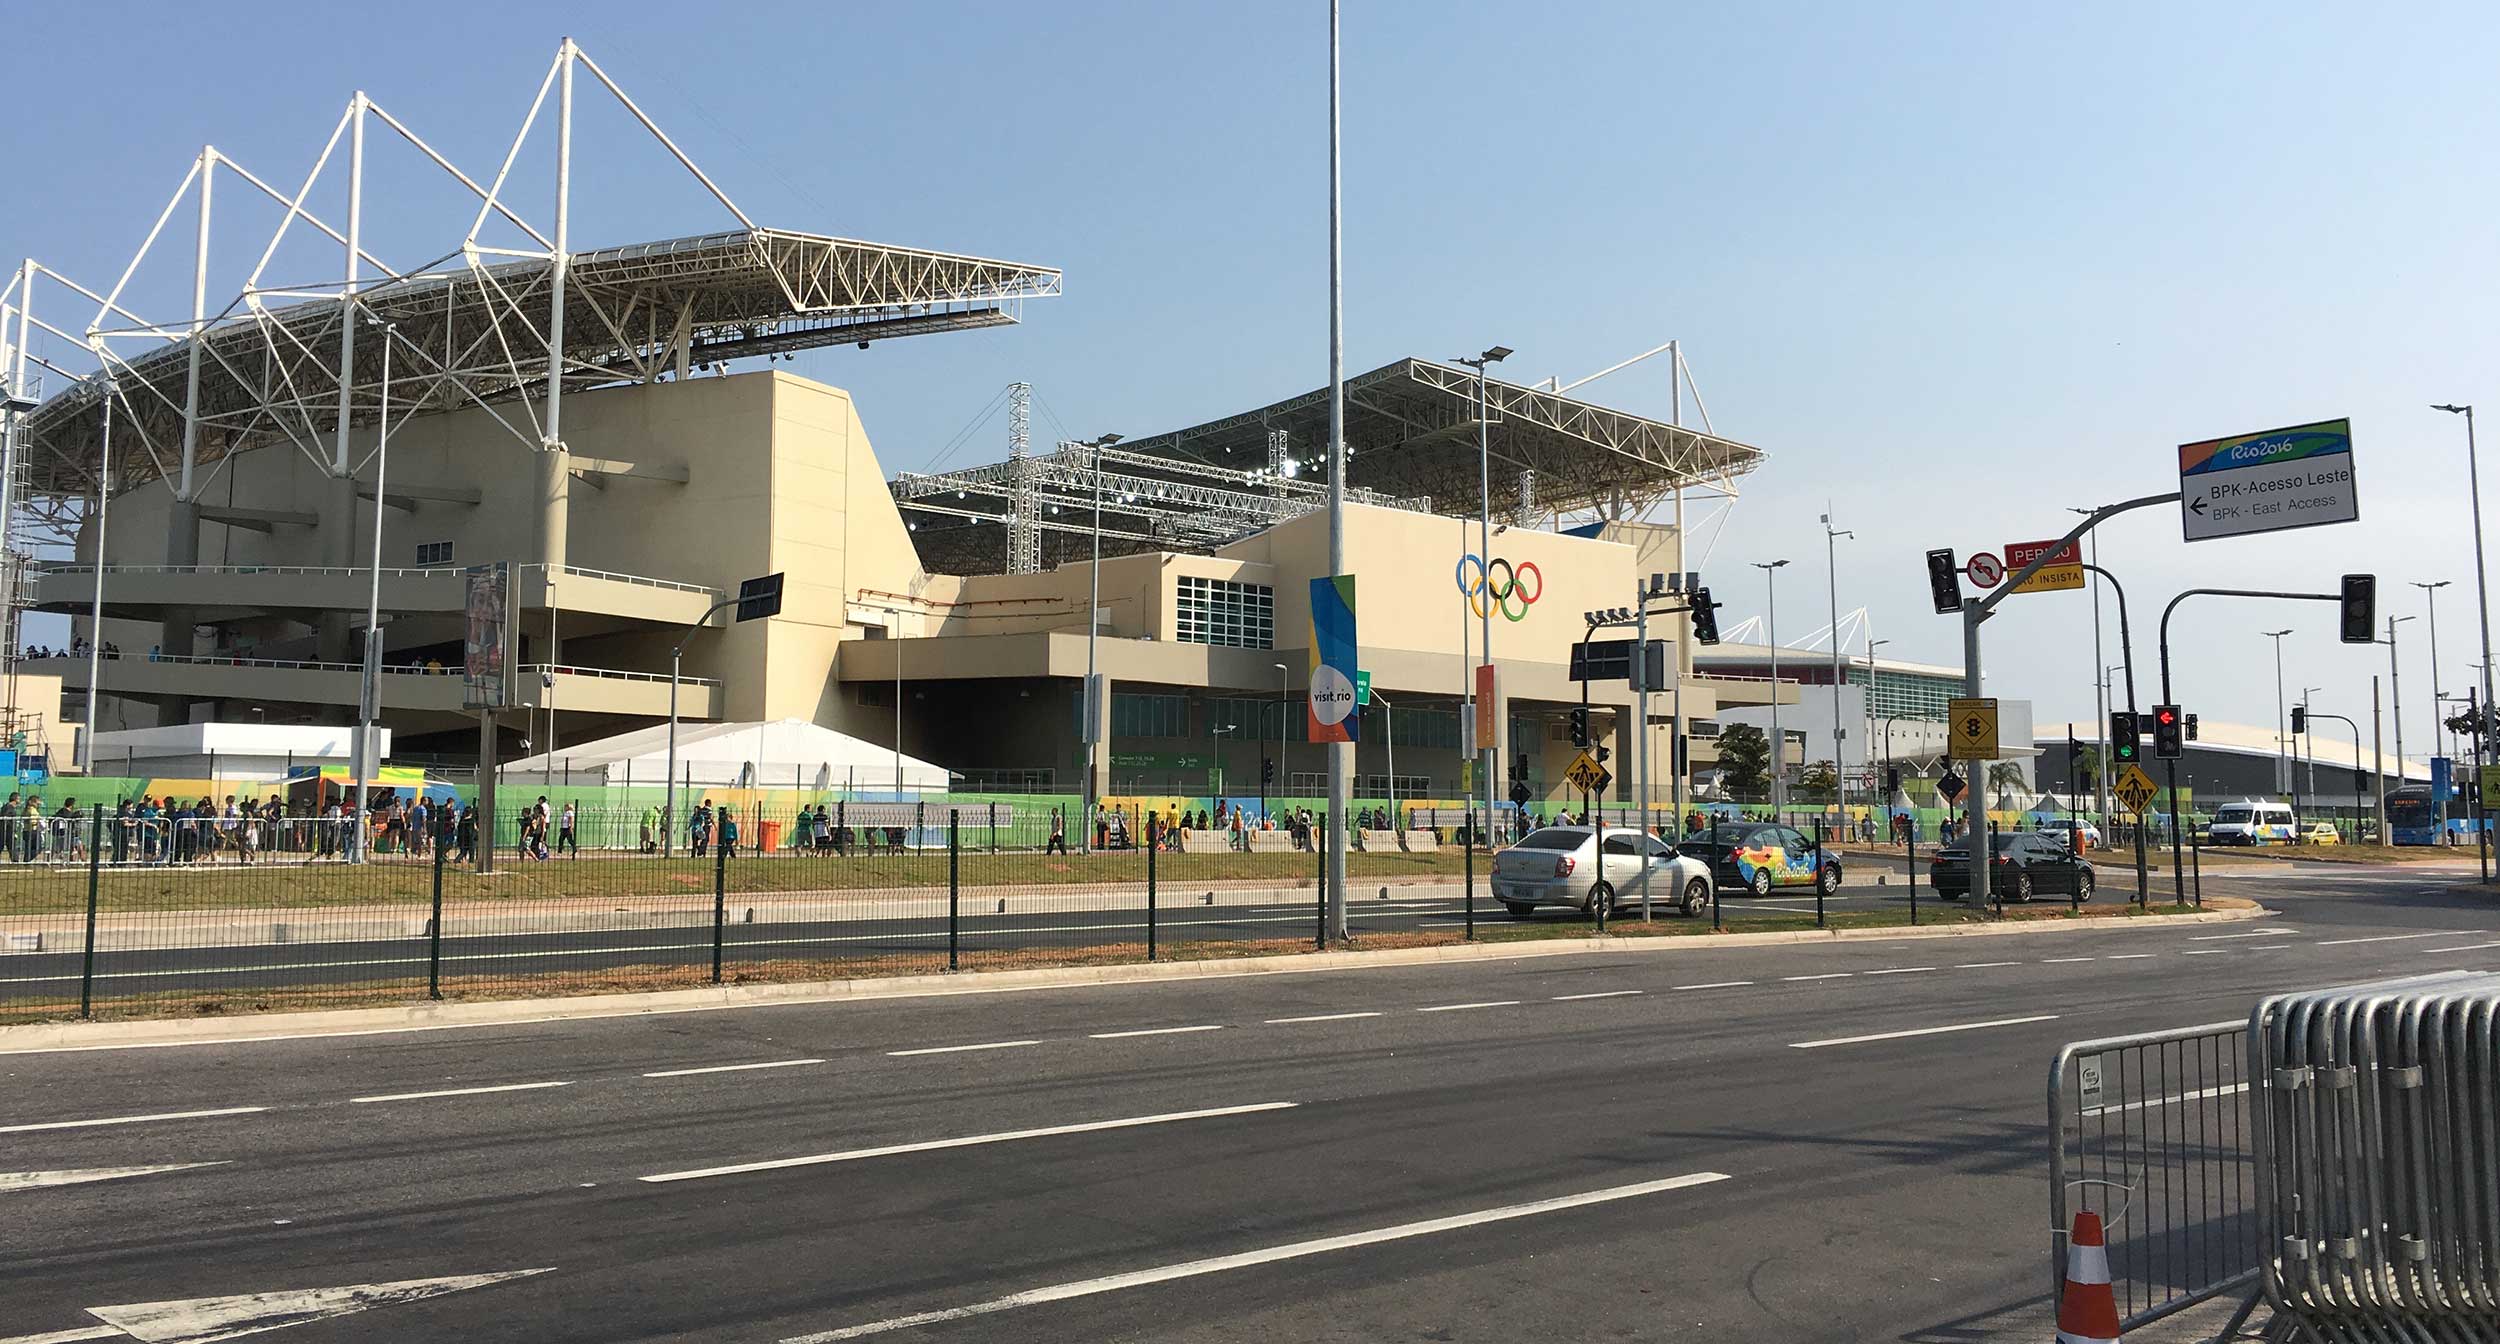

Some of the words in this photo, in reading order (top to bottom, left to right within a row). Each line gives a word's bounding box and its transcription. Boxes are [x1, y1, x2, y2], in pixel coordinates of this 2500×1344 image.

[2211, 476, 2303, 500] BPK-Acesso
[2307, 469, 2349, 486] Leste
[2213, 506, 2240, 521] BPK
[2252, 501, 2282, 516] East
[2287, 495, 2337, 511] Access
[2015, 546, 2070, 562] PERO
[2040, 572, 2080, 584] INSISTA
